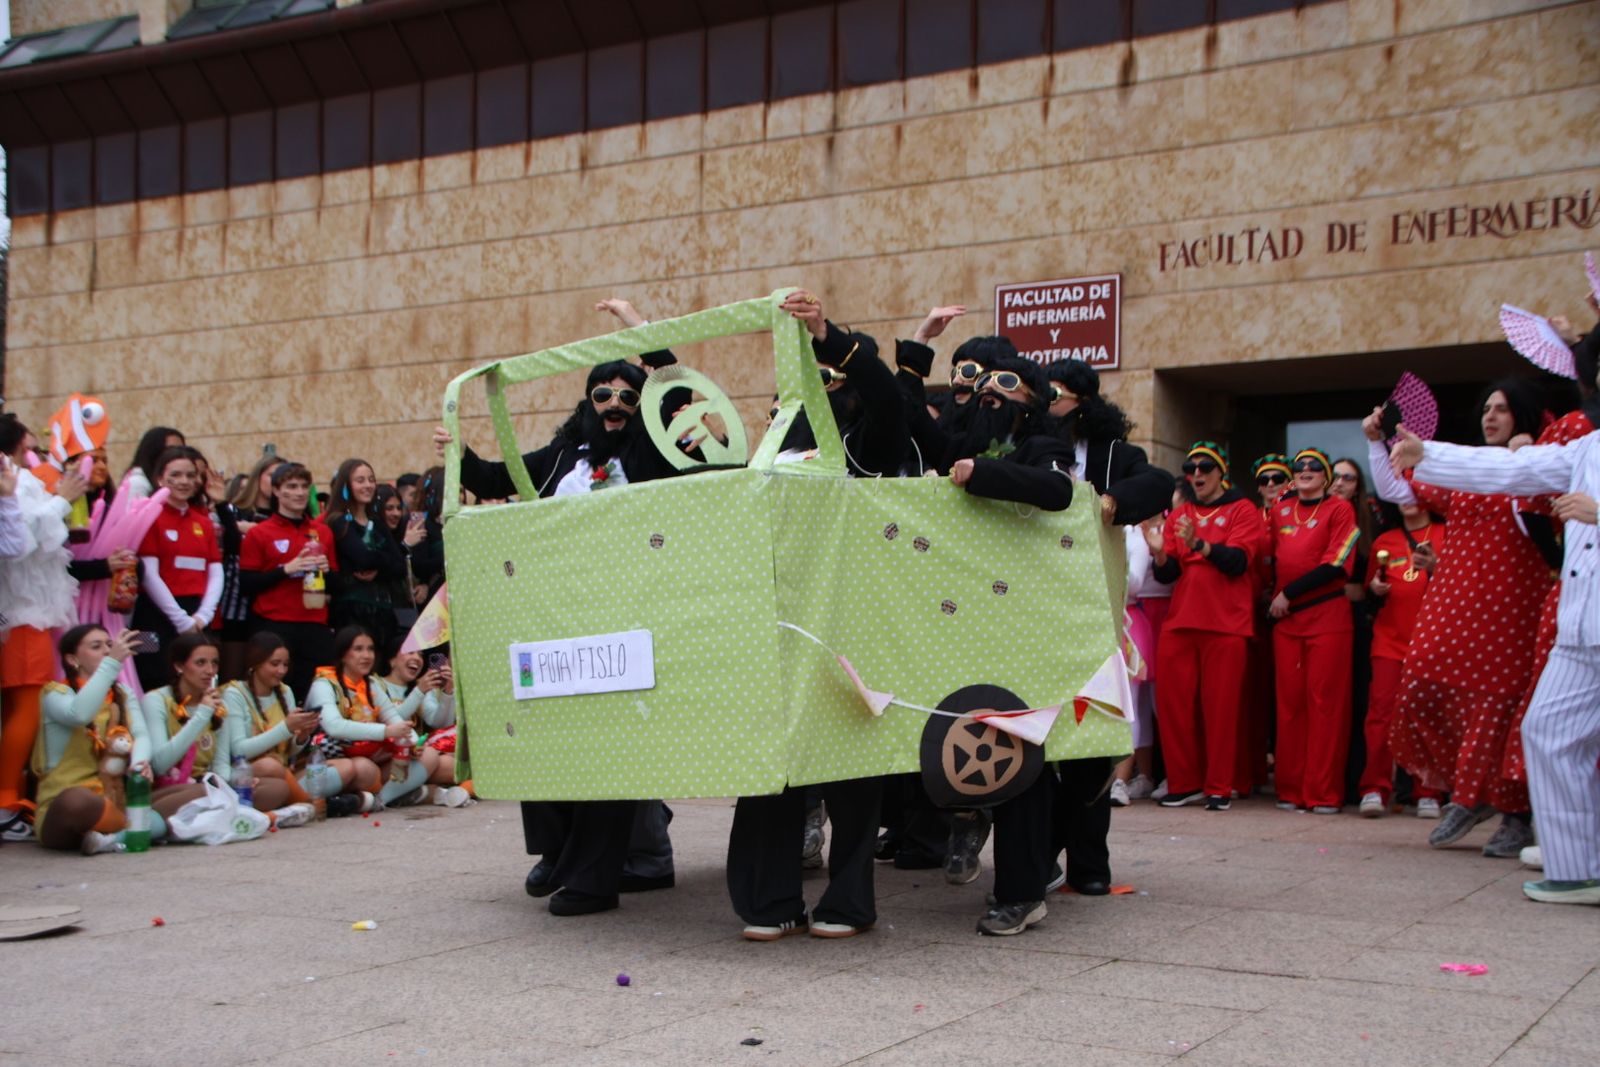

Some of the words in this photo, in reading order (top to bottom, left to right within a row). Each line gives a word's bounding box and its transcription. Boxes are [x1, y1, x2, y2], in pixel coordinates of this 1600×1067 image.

[1158, 226, 1305, 272] FACULTAD
[1326, 220, 1369, 254] DE
[1003, 285, 1085, 308] FACULTAD
[1089, 282, 1111, 301] DE
[1006, 301, 1106, 329] ENFERMERÍA
[1049, 328, 1061, 344] Y
[1017, 345, 1109, 364] IOTERAPIA
[538, 650, 572, 683] PUTA
[577, 643, 627, 680] FISIO
